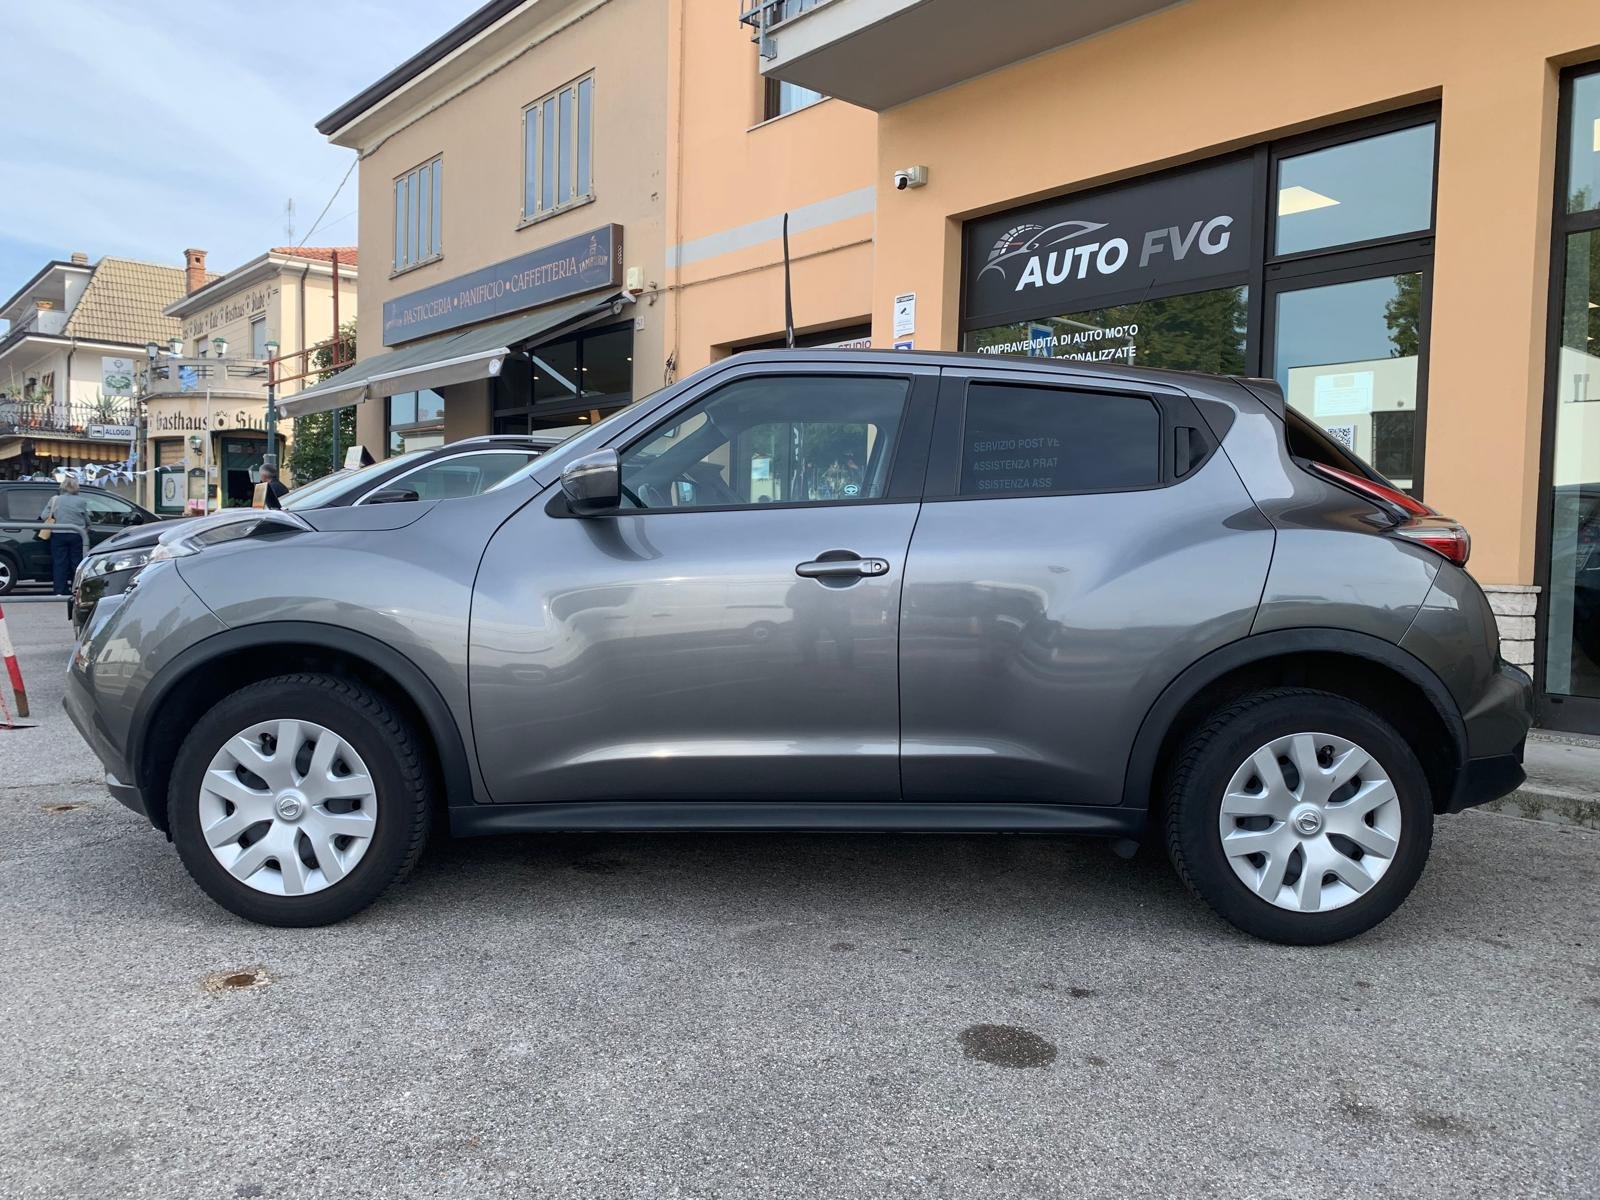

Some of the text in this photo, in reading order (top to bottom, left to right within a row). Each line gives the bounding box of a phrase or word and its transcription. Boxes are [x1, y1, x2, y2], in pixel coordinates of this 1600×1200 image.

[1015, 215, 1234, 291] AUTO FVG
[403, 256, 578, 326] PASTICCERIA PANIFICIO CAFFETTERIA
[977, 324, 1139, 354] COMPRAVENDITA DI AUTO MOTO
[1050, 345, 1137, 362] ONALIZZATE
[156, 410, 207, 431] Gasthaus
[105, 428, 131, 436] ALLOGGI
[974, 440, 1016, 453] SERVIZIO
[1018, 438, 1044, 449] POST
[974, 459, 1030, 472] ASSISTENZA
[976, 479, 1029, 490] SSISTENZA
